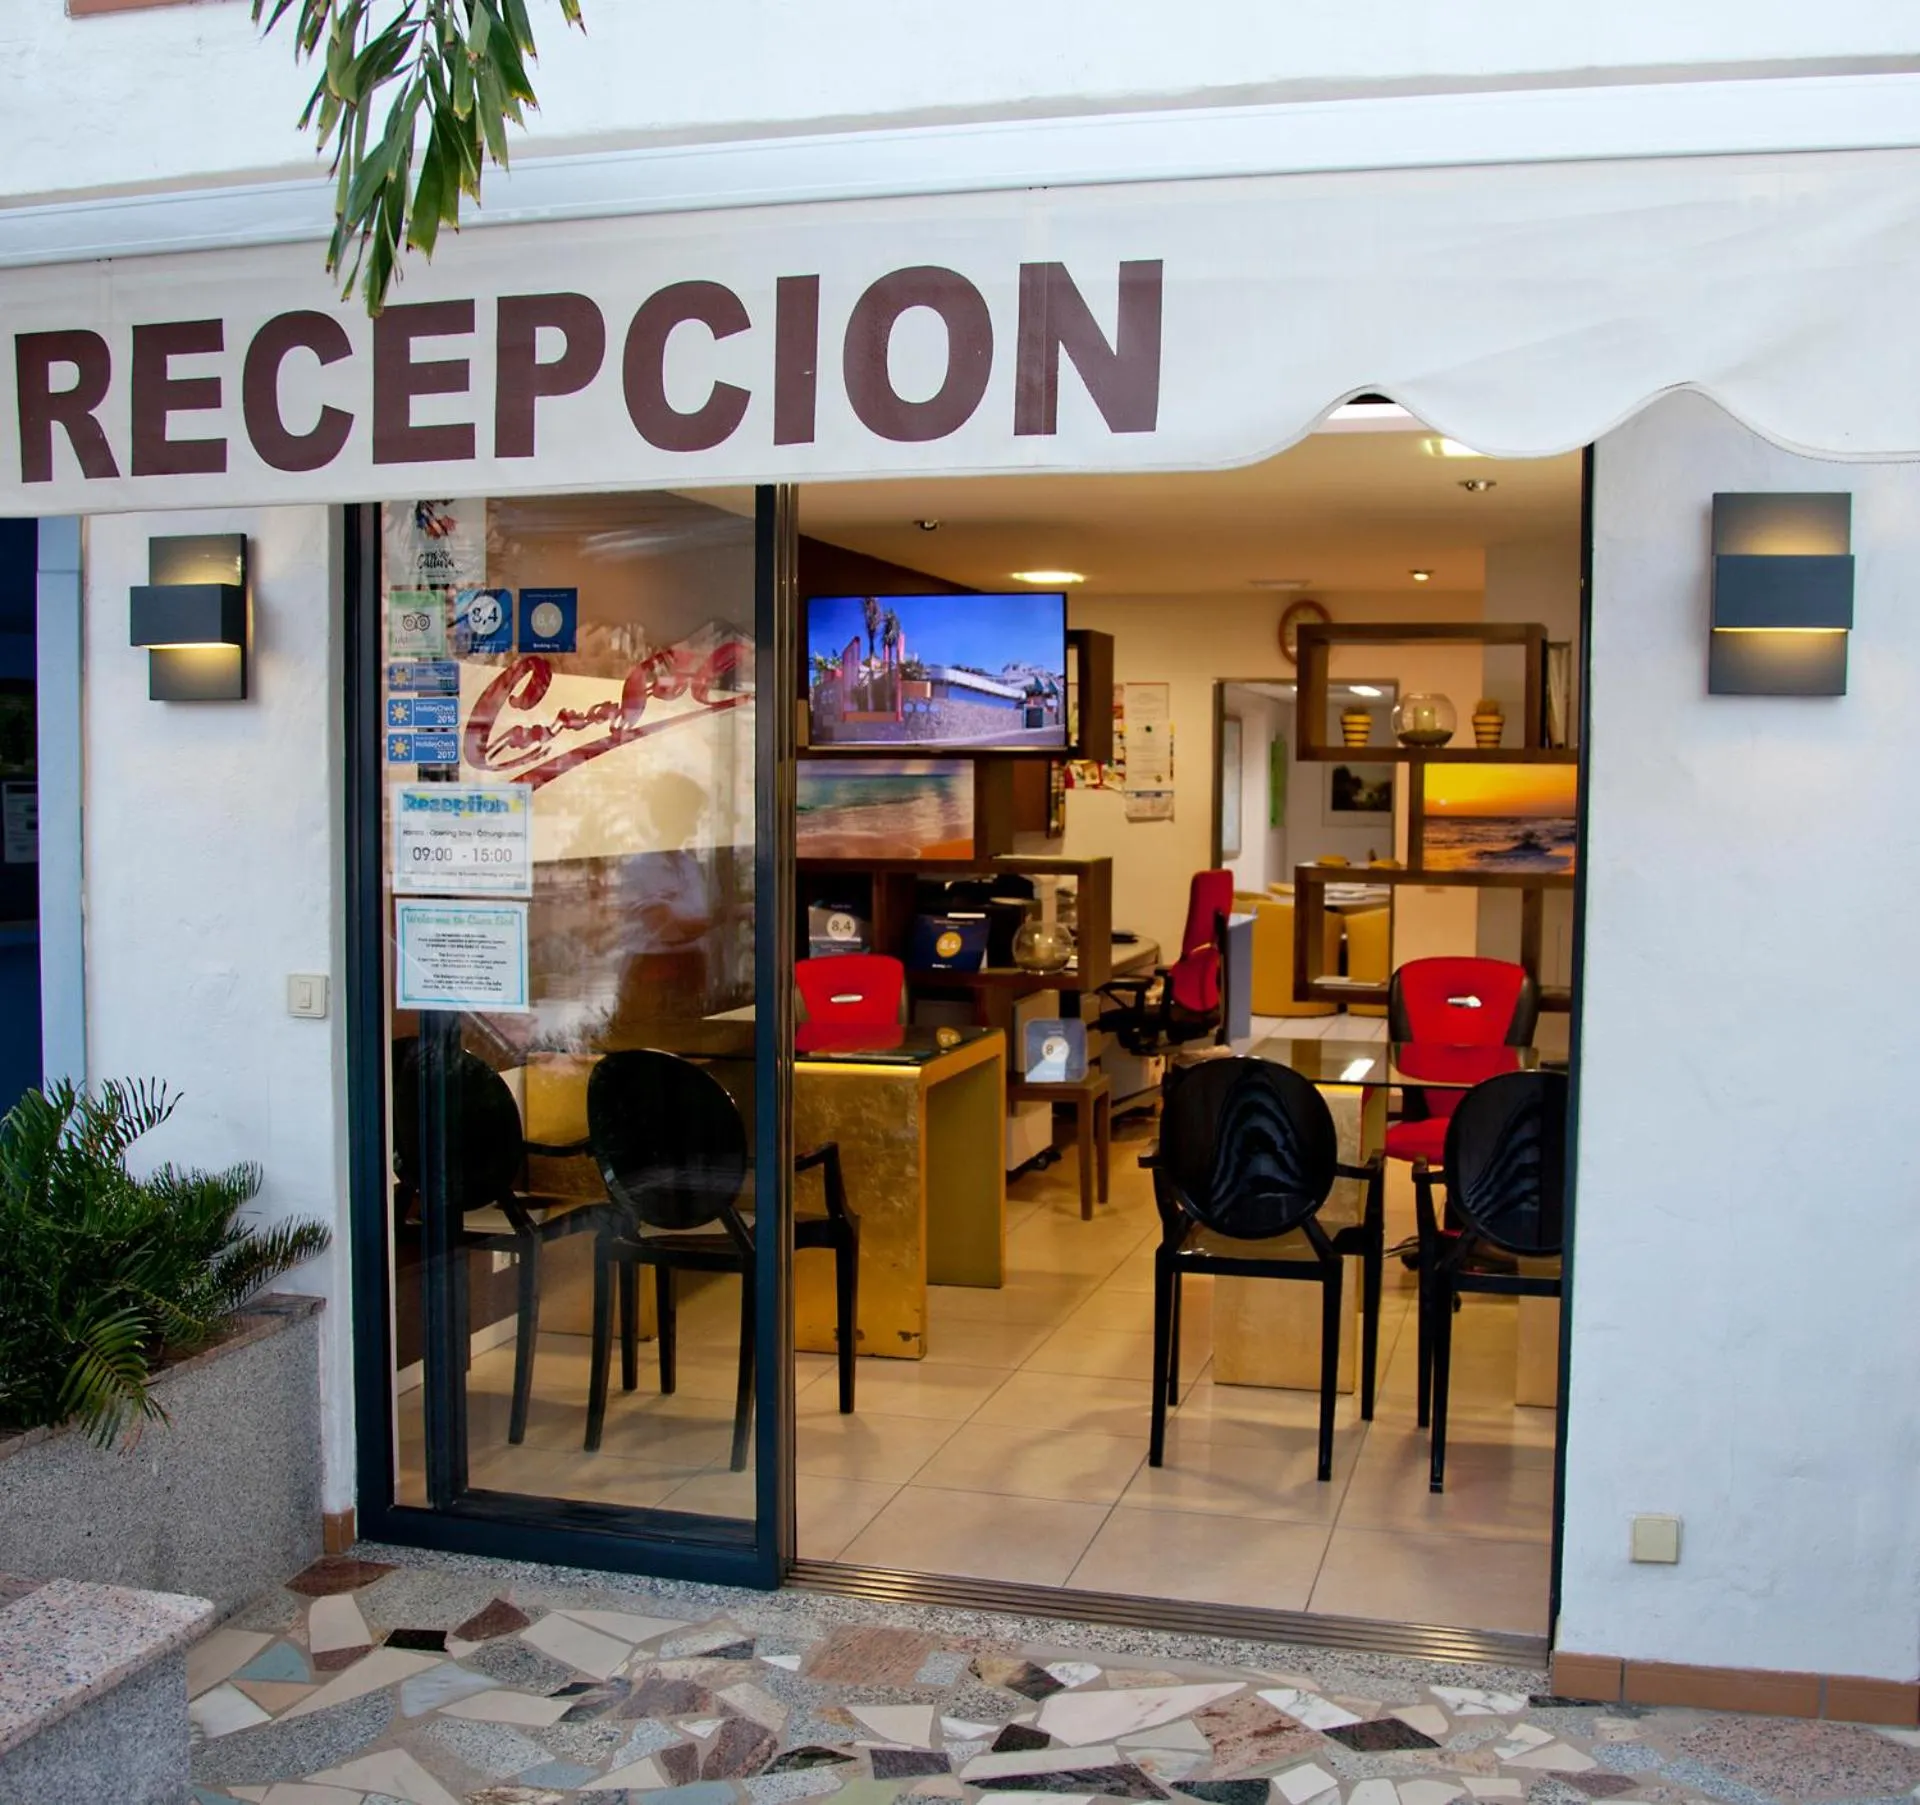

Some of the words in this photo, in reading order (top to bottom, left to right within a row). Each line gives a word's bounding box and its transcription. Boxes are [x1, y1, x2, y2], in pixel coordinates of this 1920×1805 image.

[15, 258, 1164, 483] RECEPCION
[471, 607, 498, 625] 8,4
[437, 751, 456, 759] 2017
[402, 794, 509, 817] Reception
[412, 846, 453, 862] 09:00
[473, 848, 512, 863] 15:00
[831, 920, 850, 933] 8,4
